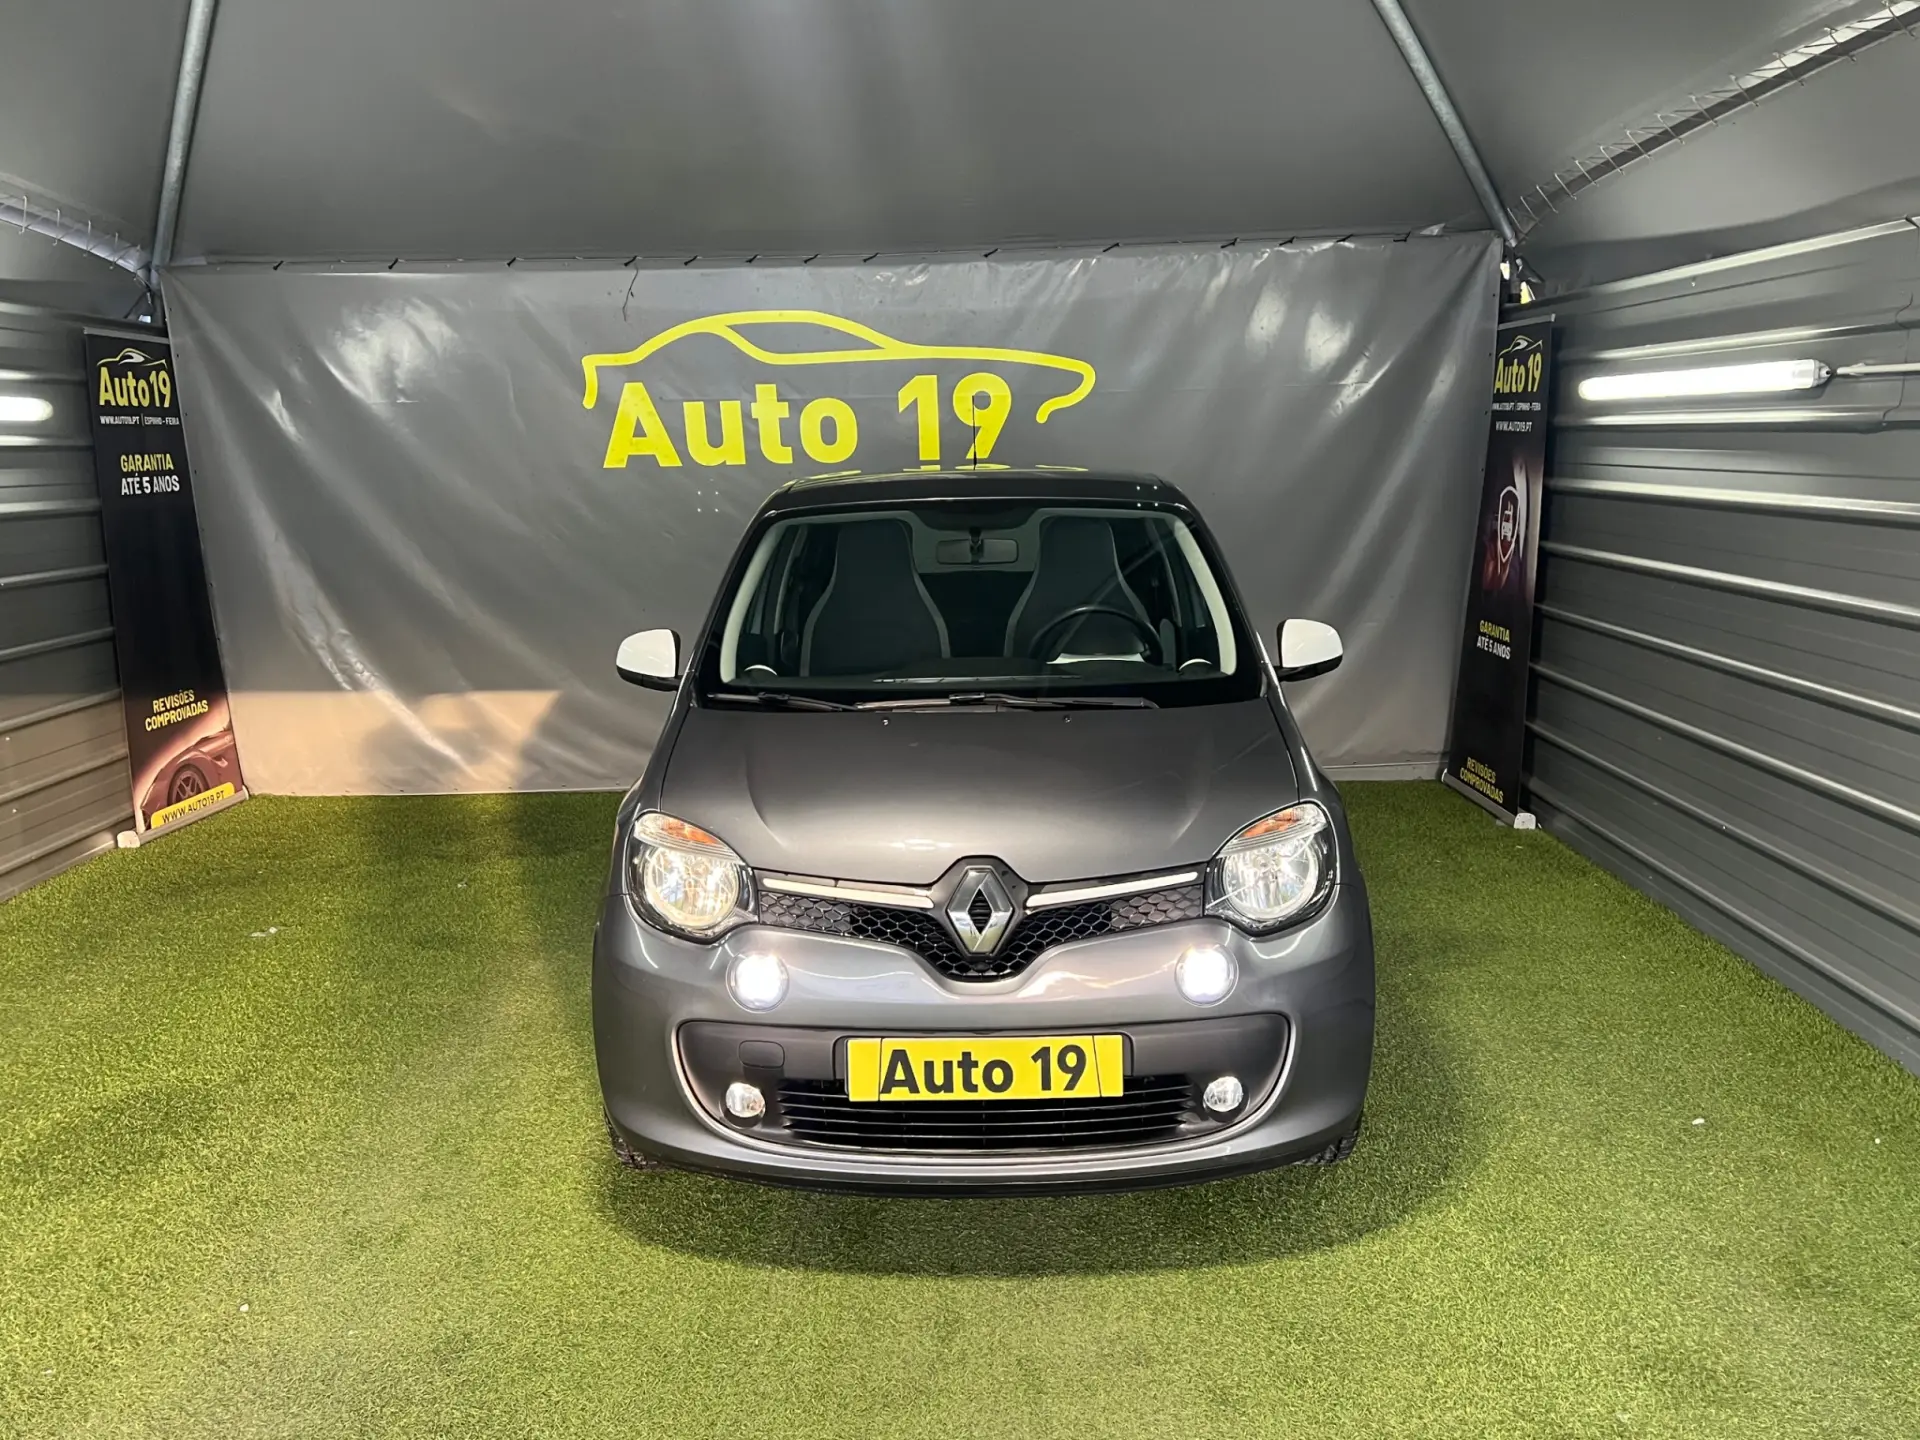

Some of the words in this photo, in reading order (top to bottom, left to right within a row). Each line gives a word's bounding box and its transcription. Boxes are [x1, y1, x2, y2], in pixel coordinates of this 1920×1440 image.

[1494, 358, 1526, 394] Auto
[1527, 352, 1542, 393] 19
[603, 382, 857, 468] Auto
[898, 372, 1012, 461] 19
[120, 453, 174, 472] GARANTIA
[142, 476, 151, 493] 5
[153, 475, 180, 492] ANOS
[1480, 620, 1510, 643] GARANTIA
[1488, 639, 1494, 653] 5
[1493, 641, 1511, 660] ANOS
[145, 700, 209, 731] COMPROVADAS
[152, 689, 195, 713] REVISÕES
[1466, 756, 1496, 784] REVISÕES
[1460, 767, 1504, 804] COMPROVADAS
[161, 790, 225, 824] WWW.AUTO19.PT
[880, 1049, 1014, 1095] Auto
[1031, 1044, 1087, 1091] 19
